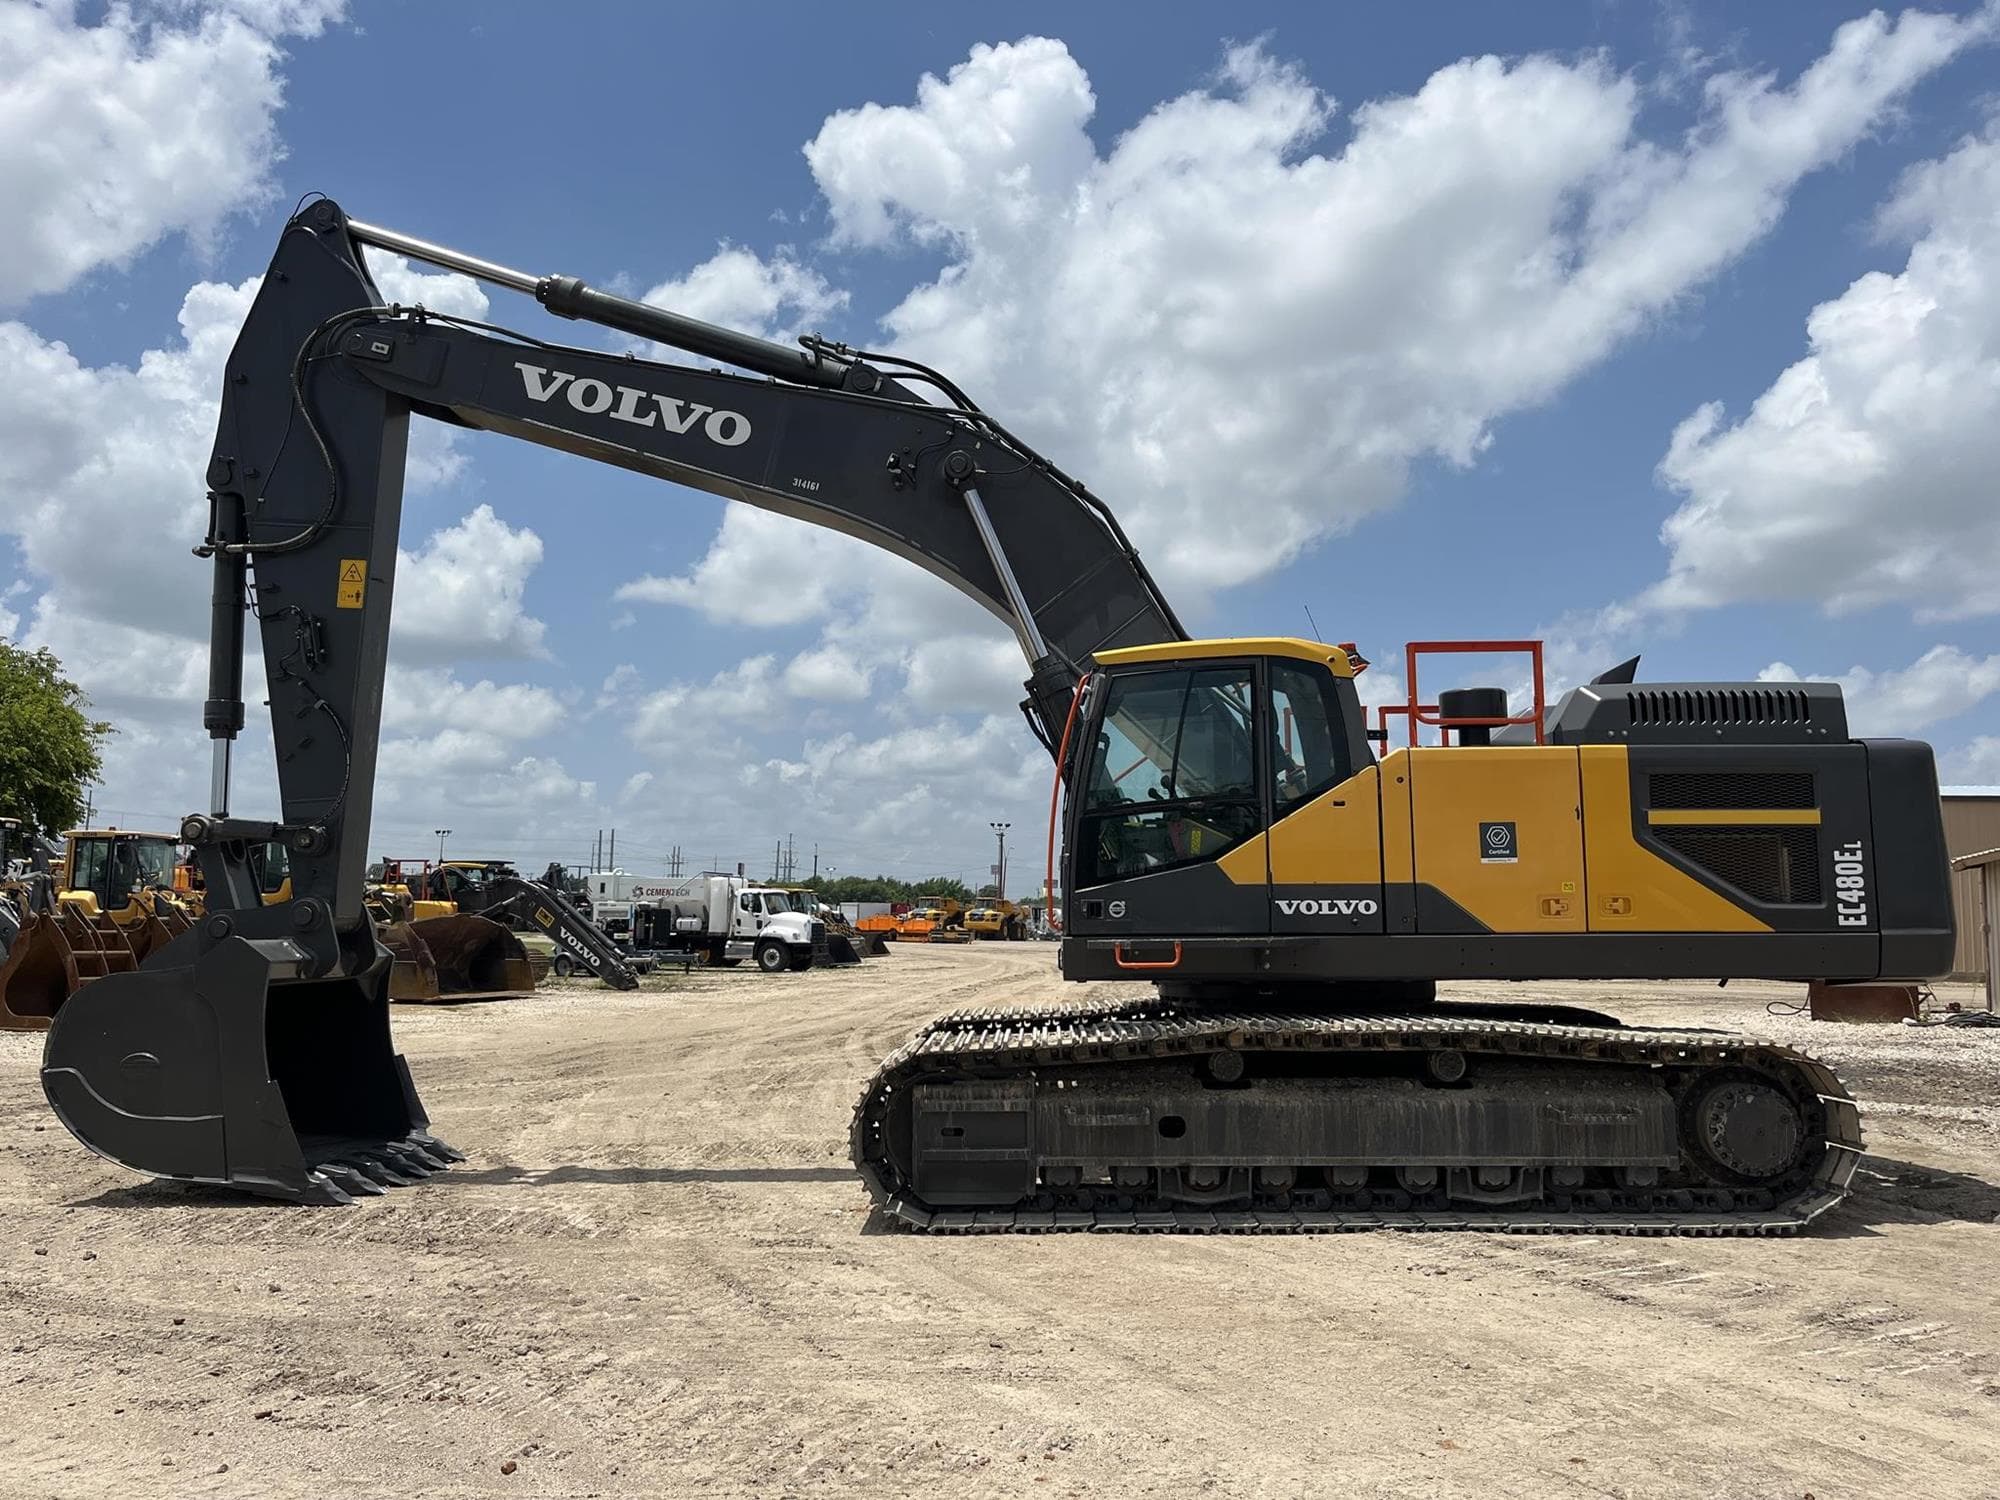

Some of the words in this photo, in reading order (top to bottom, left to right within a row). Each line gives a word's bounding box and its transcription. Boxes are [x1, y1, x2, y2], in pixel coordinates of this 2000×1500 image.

[514, 362, 752, 446] VOLVO
[792, 478, 820, 491] 314161
[1275, 900, 1378, 915] VOLVO
[560, 926, 601, 967] VOLVO
